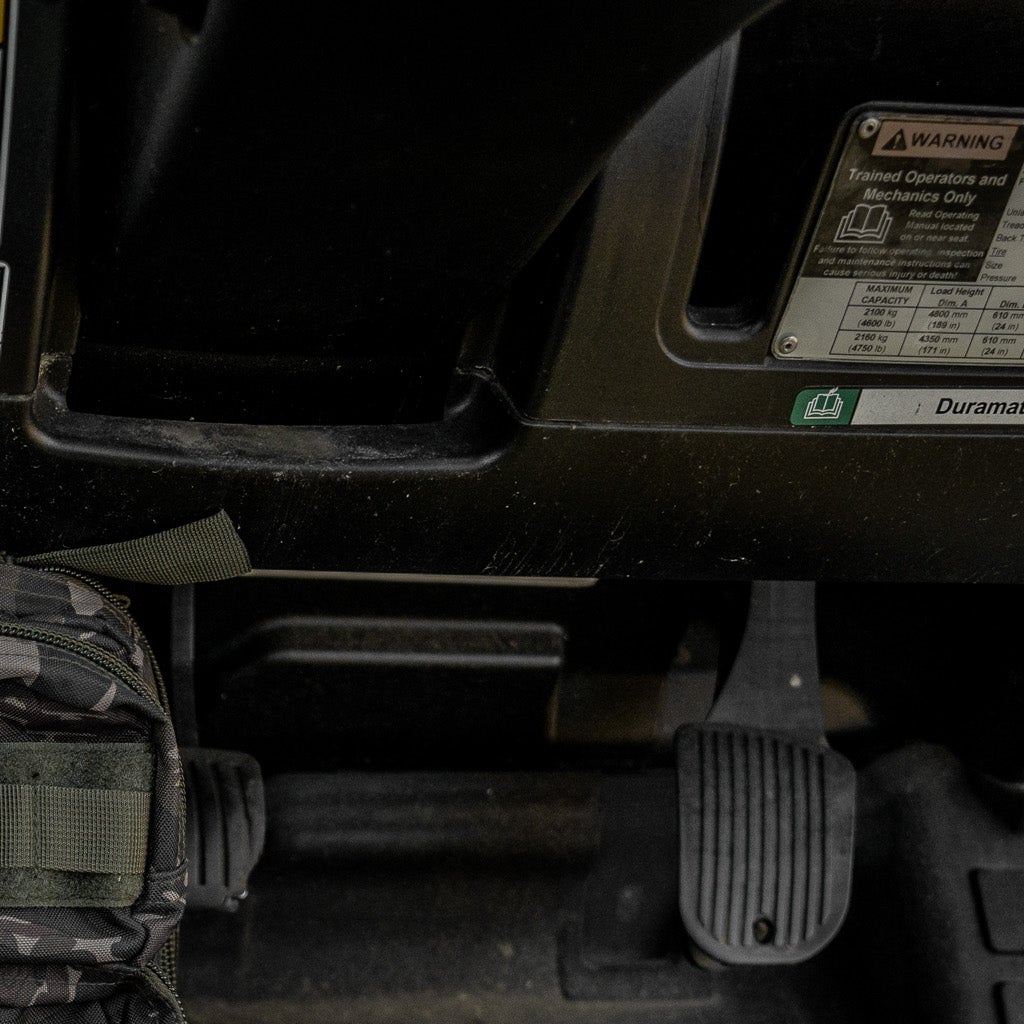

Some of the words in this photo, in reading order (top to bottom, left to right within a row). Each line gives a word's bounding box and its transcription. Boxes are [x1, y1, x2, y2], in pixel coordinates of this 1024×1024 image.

[911, 133, 1005, 150] WARNING
[849, 168, 901, 183] Trained
[905, 170, 975, 186] Operators
[979, 174, 1008, 186] and
[863, 188, 939, 203] Mechanics
[943, 191, 977, 207] Only
[909, 210, 933, 218] Read
[934, 210, 979, 221] Operating
[905, 221, 937, 230] Manual
[940, 222, 975, 232] located
[913, 234, 924, 242] or
[995, 234, 1017, 242] Back
[847, 246, 857, 254] to
[990, 248, 1007, 256] Tire
[817, 257, 835, 265] and
[837, 258, 896, 267] maintenance
[897, 260, 952, 269] instructions
[985, 261, 1003, 269] Size
[823, 270, 855, 278] cause
[856, 270, 888, 278] serious
[889, 270, 915, 280] injury
[980, 273, 1017, 282] Pressure
[866, 284, 913, 293] MAXIMUM
[930, 287, 954, 296] Load
[955, 287, 985, 298] Height
[861, 296, 910, 305] CAPACITY
[938, 299, 956, 307] Dim.
[959, 299, 968, 307] A
[999, 300, 1020, 309] Dim.
[864, 309, 885, 317] 2100
[886, 309, 898, 318] kg
[928, 310, 950, 318] 4800
[992, 311, 1008, 320] 610
[857, 319, 882, 328] (4600
[884, 319, 896, 328] lb)
[949, 321, 961, 330] in)
[991, 322, 1007, 331] (24
[1008, 322, 1019, 332] in)
[854, 334, 876, 342] 2160
[878, 334, 888, 344] kg
[919, 335, 940, 344] 4350
[982, 336, 998, 345] 610
[1000, 337, 1016, 345] mm
[848, 344, 873, 353] (4750
[875, 344, 887, 354] lb)
[918, 346, 938, 355] (171
[939, 346, 951, 356] in)
[981, 346, 996, 356] (24
[997, 347, 1009, 356] in)
